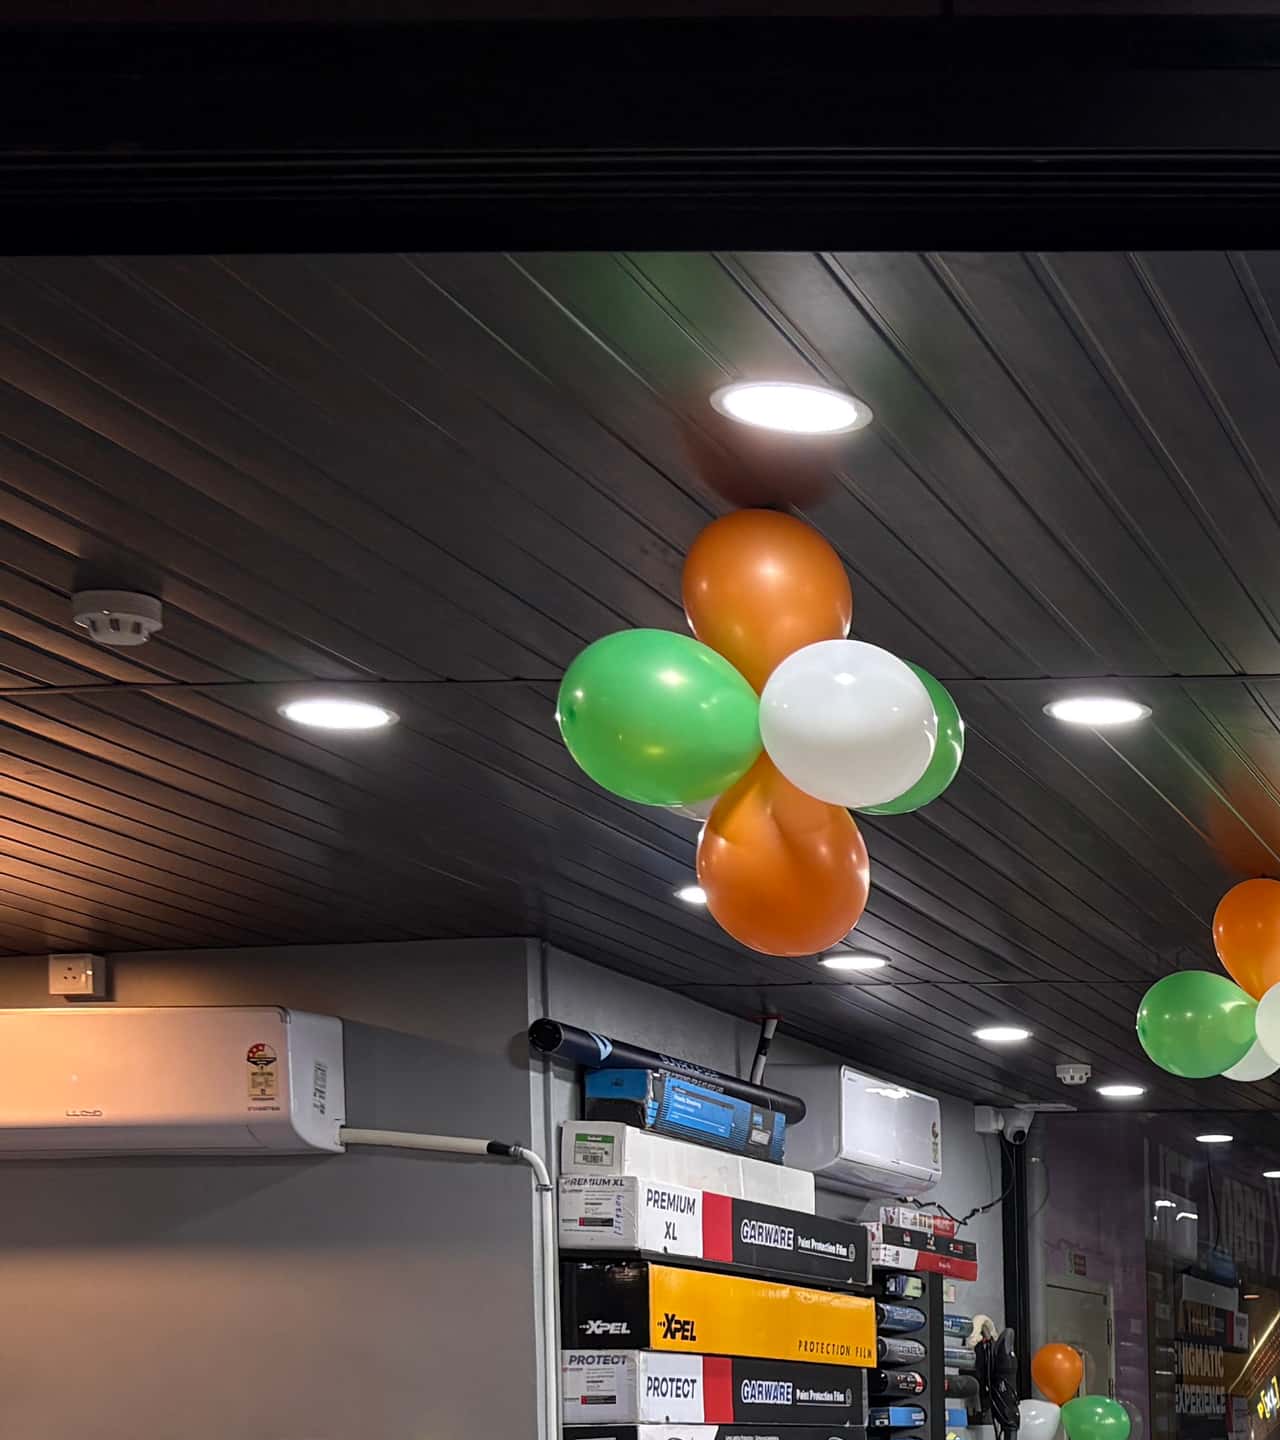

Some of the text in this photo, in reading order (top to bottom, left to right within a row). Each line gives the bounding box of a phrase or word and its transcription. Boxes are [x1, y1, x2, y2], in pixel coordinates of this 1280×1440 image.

[646, 1188, 696, 1216] PREMIUM
[664, 1221, 678, 1241] XL
[741, 1219, 794, 1250] GARWARE
[584, 1320, 631, 1335] XPEL
[661, 1313, 697, 1341] XPEL
[568, 1355, 626, 1365] PROTECT
[798, 1339, 873, 1359] PROTECTION FILM
[646, 1376, 697, 1400] PROTECT
[741, 1380, 793, 1404] GARWARE
